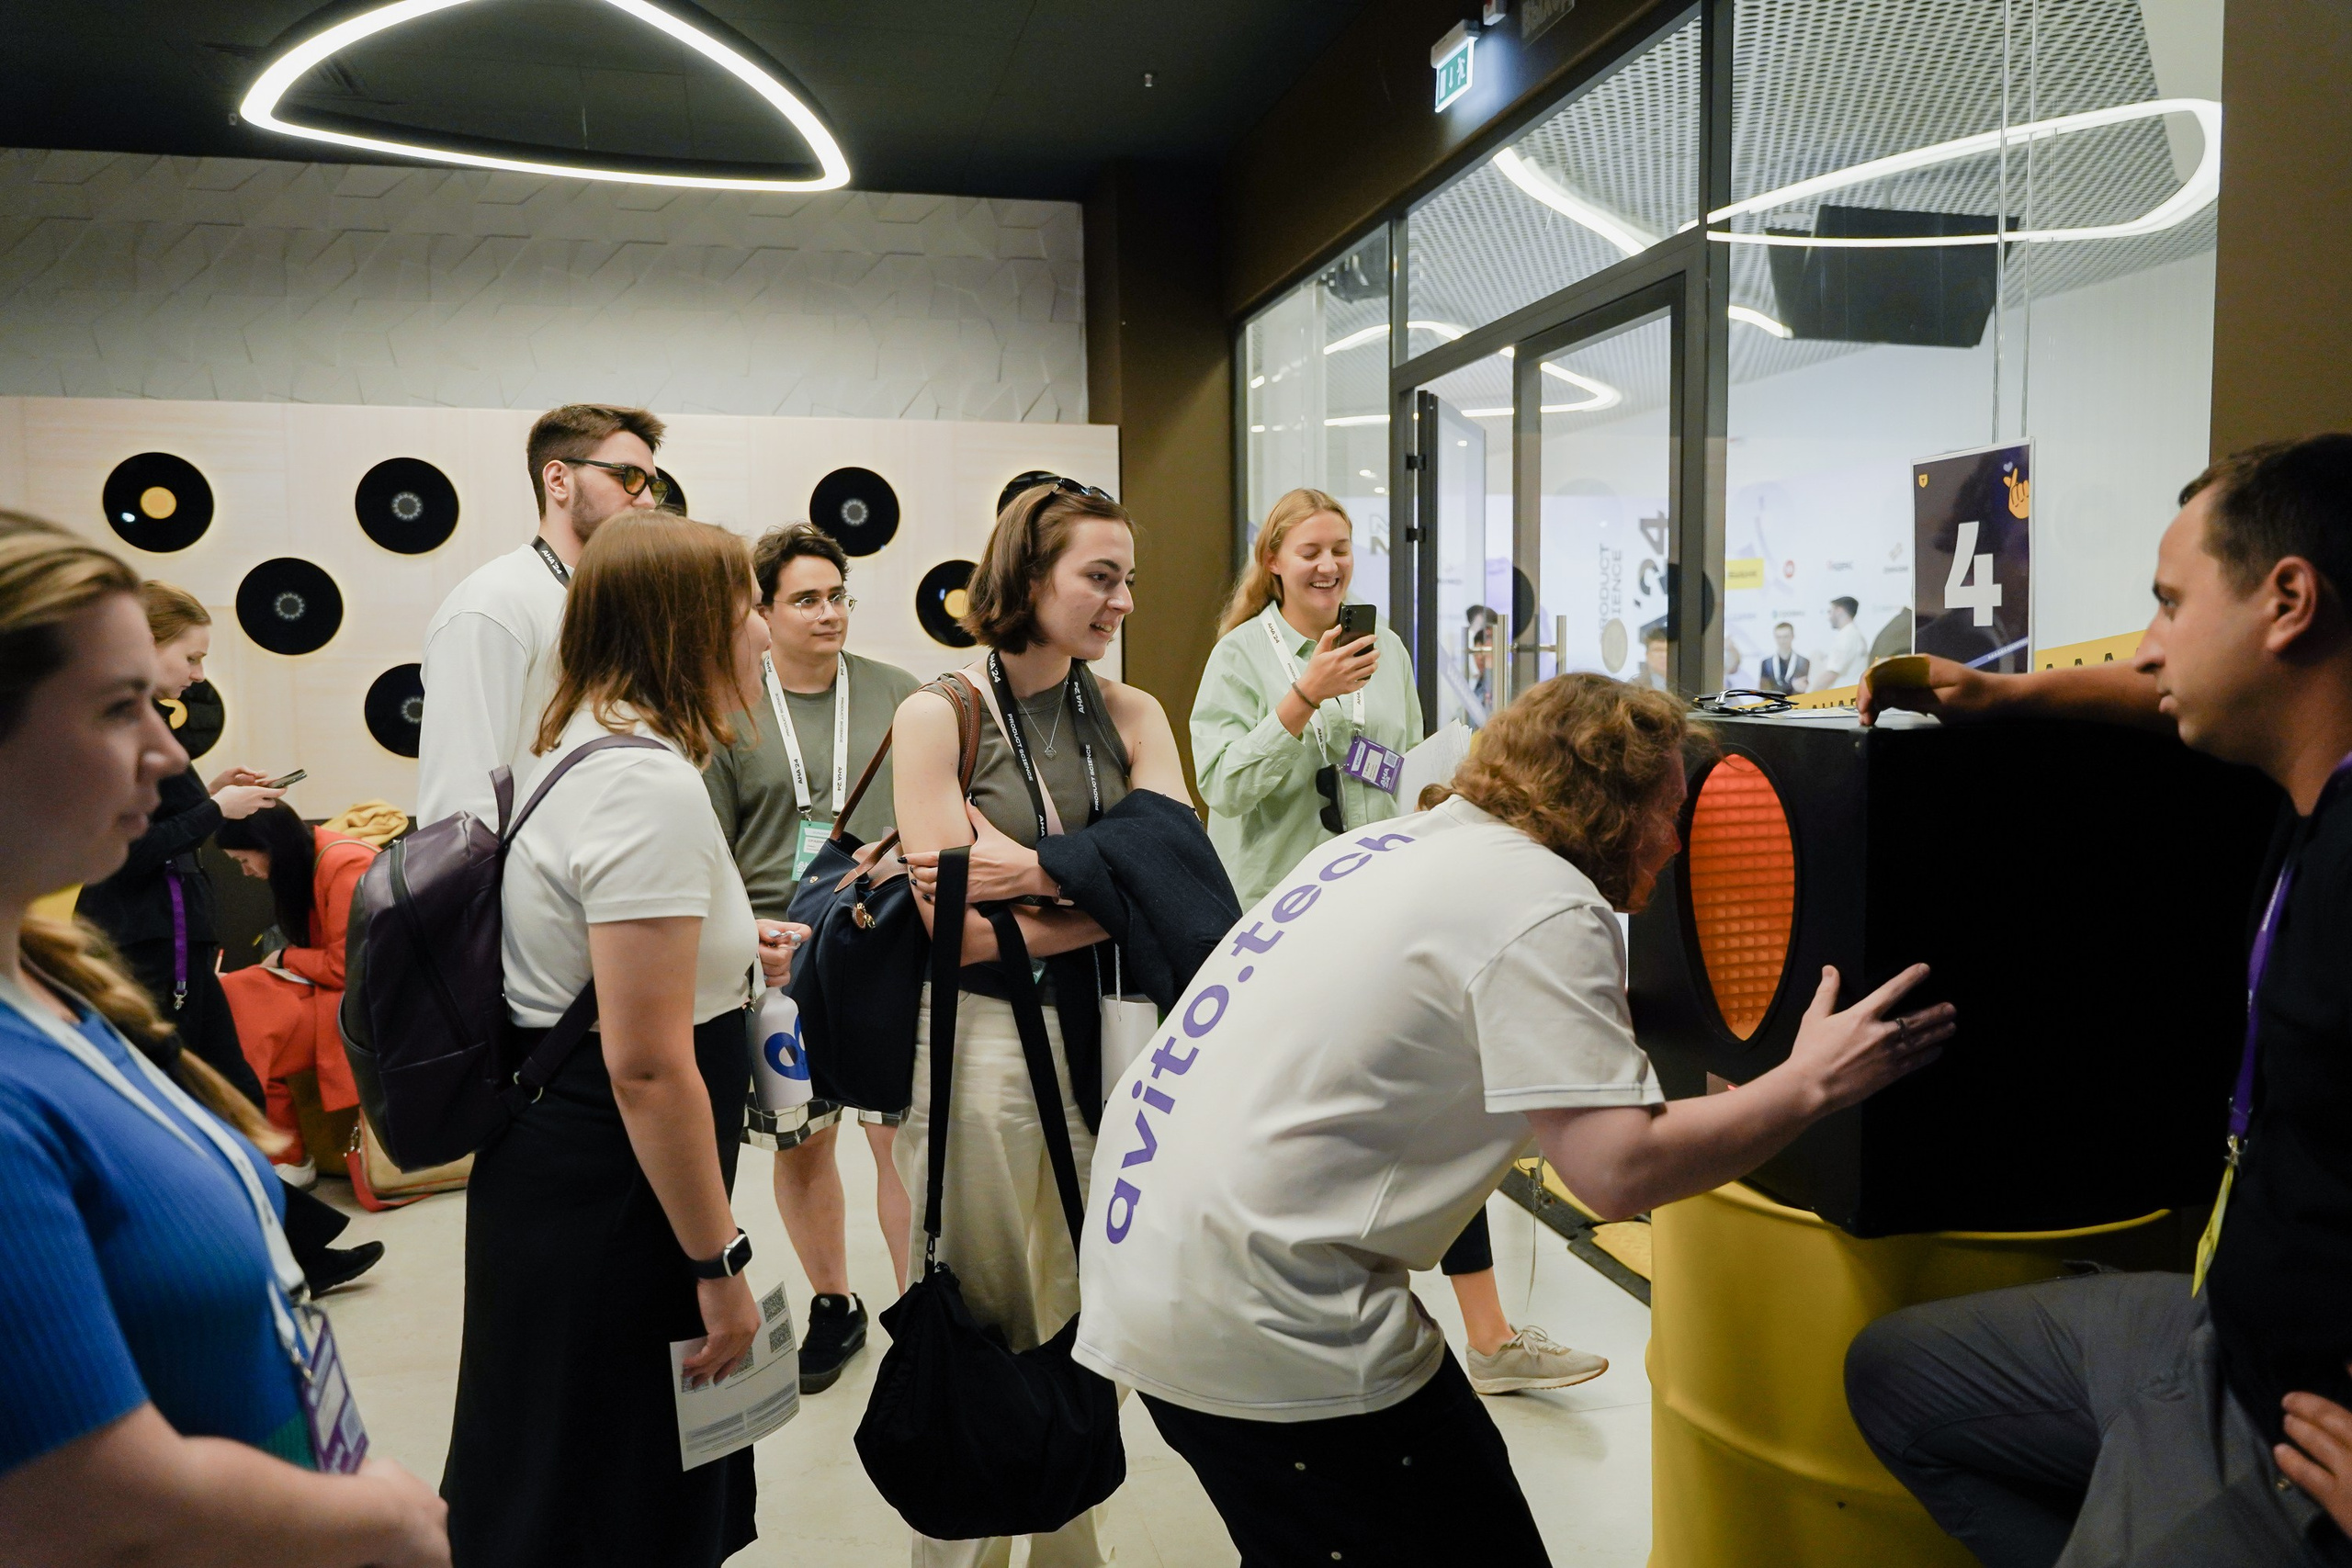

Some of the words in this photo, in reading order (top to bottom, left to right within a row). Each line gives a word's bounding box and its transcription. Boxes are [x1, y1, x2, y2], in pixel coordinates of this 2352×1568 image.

[541, 549, 563, 575] AHA'24
[1599, 543, 1610, 634] RODUCT
[1611, 549, 1622, 615] IENCE
[1944, 521, 2002, 626] 4
[1074, 682, 1086, 715] AHA'24
[1007, 713, 1023, 749] PRODUCT
[1019, 748, 1034, 782] SCIENCE
[1085, 744, 1095, 776] SCIENCE
[1091, 776, 1100, 811] PRODUCT
[1106, 833, 1417, 1245] avito.tech
